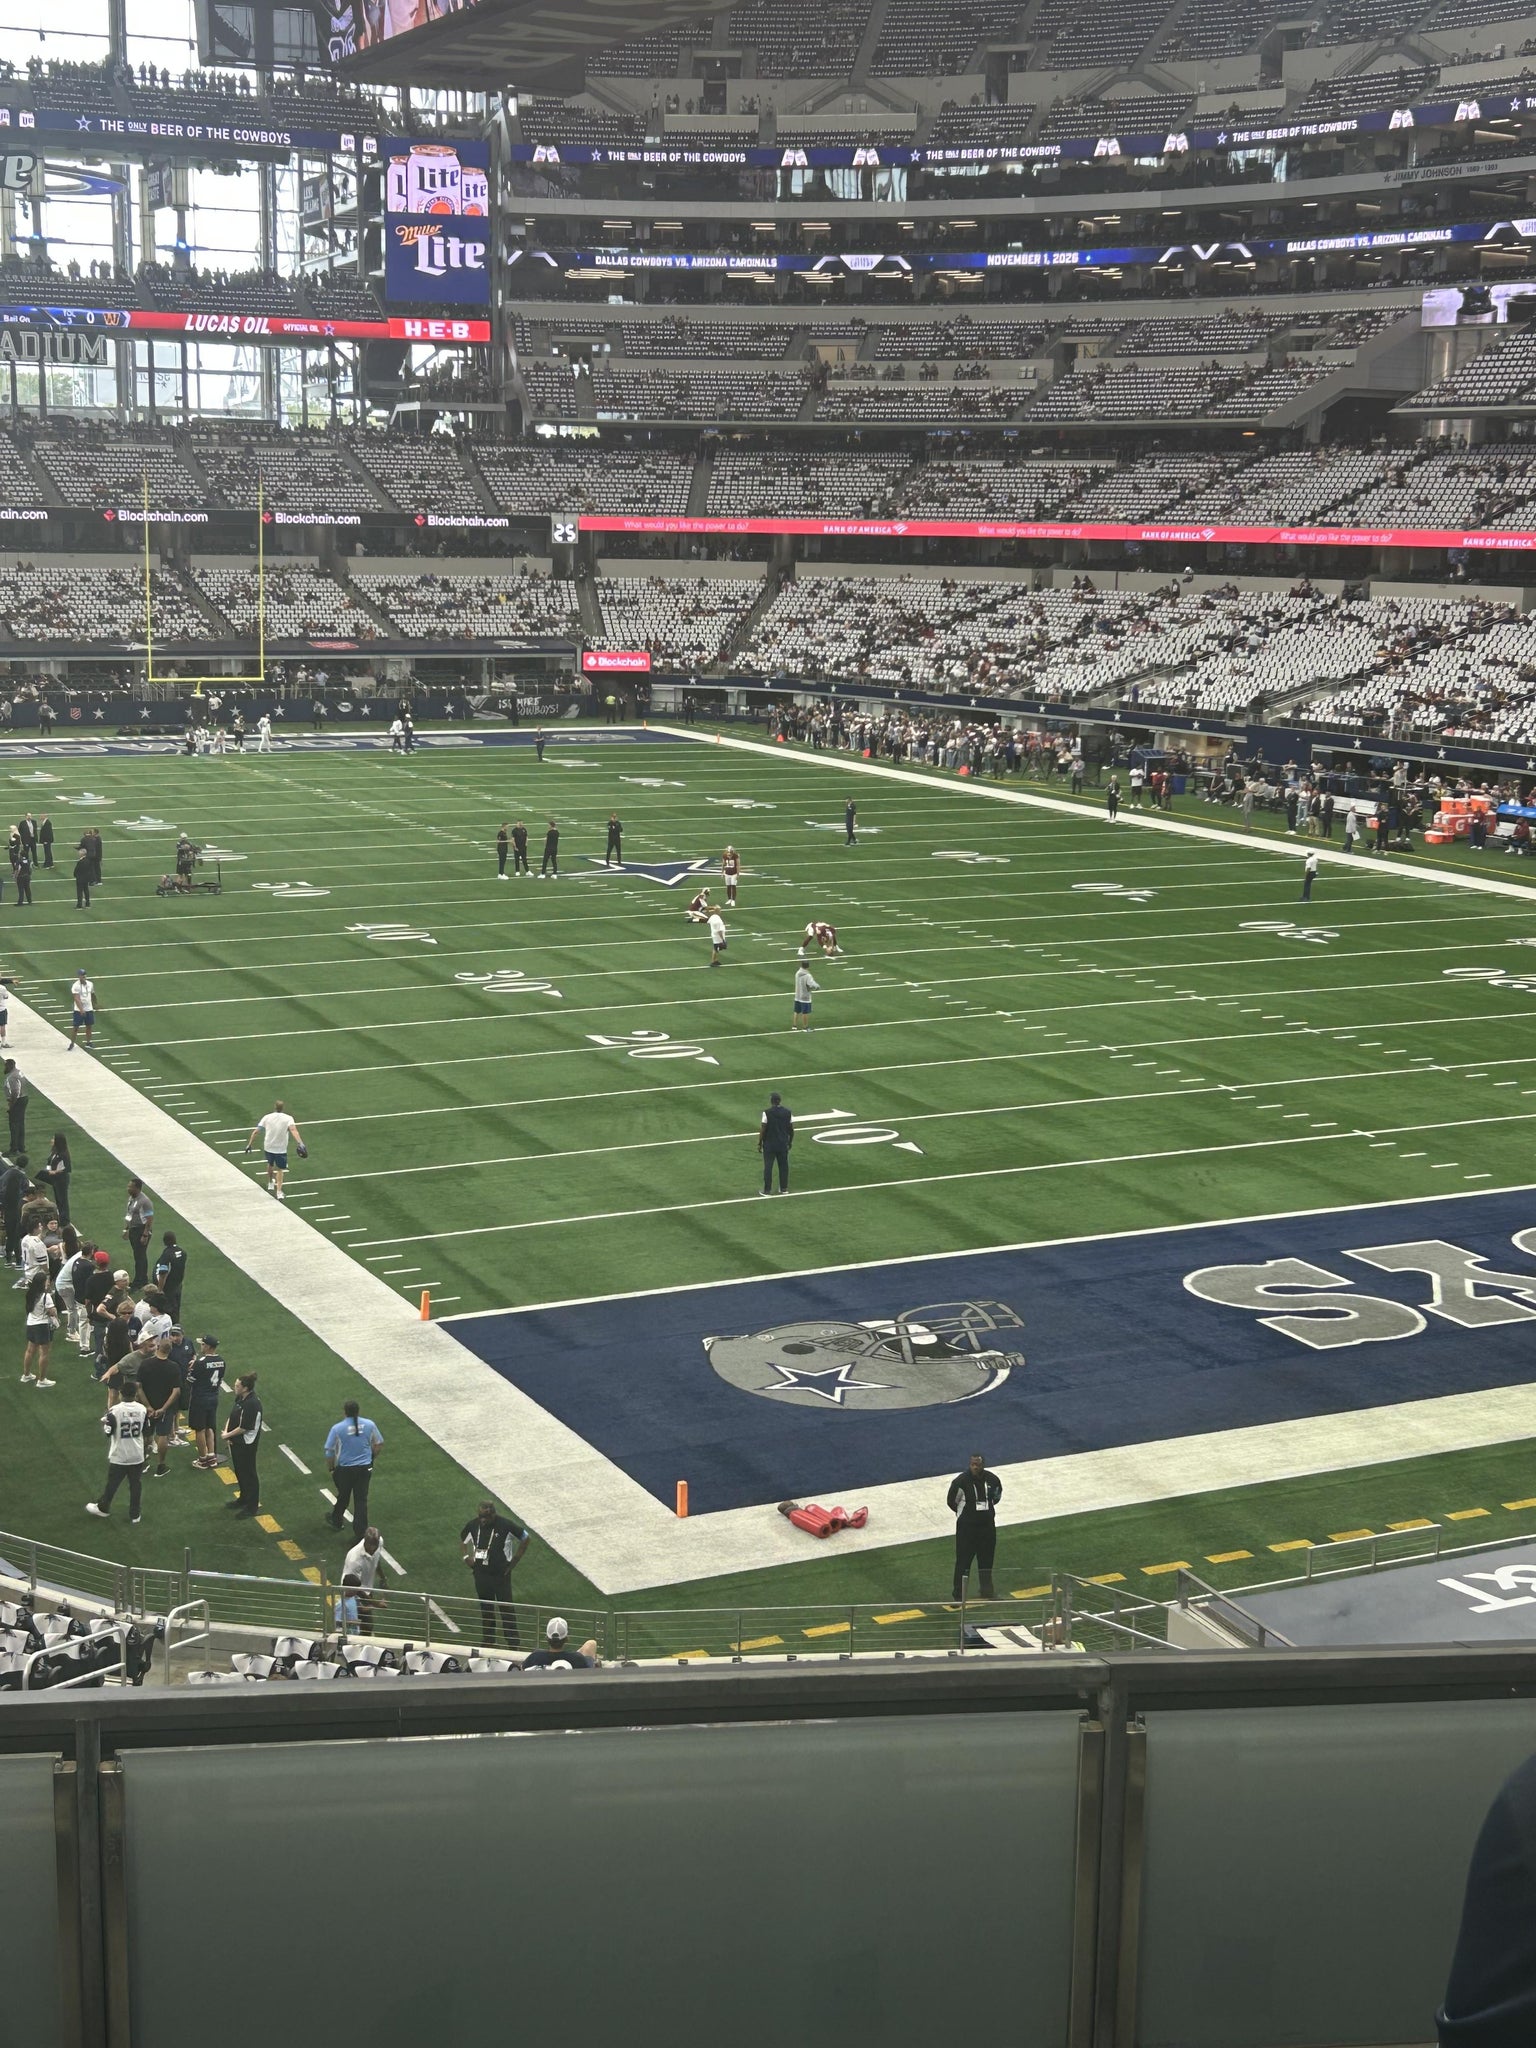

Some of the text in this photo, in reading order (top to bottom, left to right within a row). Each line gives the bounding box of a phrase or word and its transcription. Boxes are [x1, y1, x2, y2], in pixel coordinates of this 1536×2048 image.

[100, 119, 291, 145] THE ONLY BEER OF THE COWBOYS
[1232, 131, 1249, 142] THE
[1266, 128, 1288, 140] BEER
[1289, 127, 1301, 138] OF
[1301, 125, 1318, 136] THE
[1318, 119, 1358, 134] COWBOYS
[607, 151, 625, 161] THE
[643, 152, 667, 162] BEER
[669, 152, 682, 163] OF
[683, 152, 701, 163] THE
[702, 152, 746, 163] COWBOYS
[926, 150, 943, 160] THE
[961, 148, 984, 159] BEER
[986, 148, 998, 159] OF
[1000, 147, 1018, 157] THE
[1019, 145, 1061, 157] COWBOYS
[417, 166, 459, 194] Lite
[1393, 170, 1419, 182] JIMMY
[1420, 166, 1462, 180] JOHNSON
[395, 225, 443, 247] Miller
[1287, 239, 1317, 253] DALLAS
[1317, 237, 1356, 251] COWBOYS
[1371, 232, 1406, 247] ARIZONA
[1407, 229, 1452, 244] CARDINALS
[414, 236, 486, 277] Lite
[595, 255, 628, 267] DALLAS
[630, 256, 673, 267] COWBOYS
[691, 257, 728, 268] ARIZONA
[729, 257, 778, 268] CARDINALS
[987, 253, 1041, 266] NOVEMBER
[86, 312, 95, 324] 0
[184, 314, 271, 335] LUCAS OIL
[118, 510, 208, 523] Blockchain.com
[275, 513, 361, 525] Blockchain.com
[427, 515, 509, 528] Blockchain.com
[624, 520, 642, 530] What
[644, 520, 664, 530] would
[665, 522, 678, 532] you
[823, 525, 892, 535] BANK OF AMERICA
[1142, 531, 1200, 541] BANK OF AMERICA
[1463, 538, 1532, 548] BANK OF AMERICA
[598, 656, 647, 668] Blockchain
[210, 1369, 220, 1386] 4
[120, 1421, 141, 1439] 22
